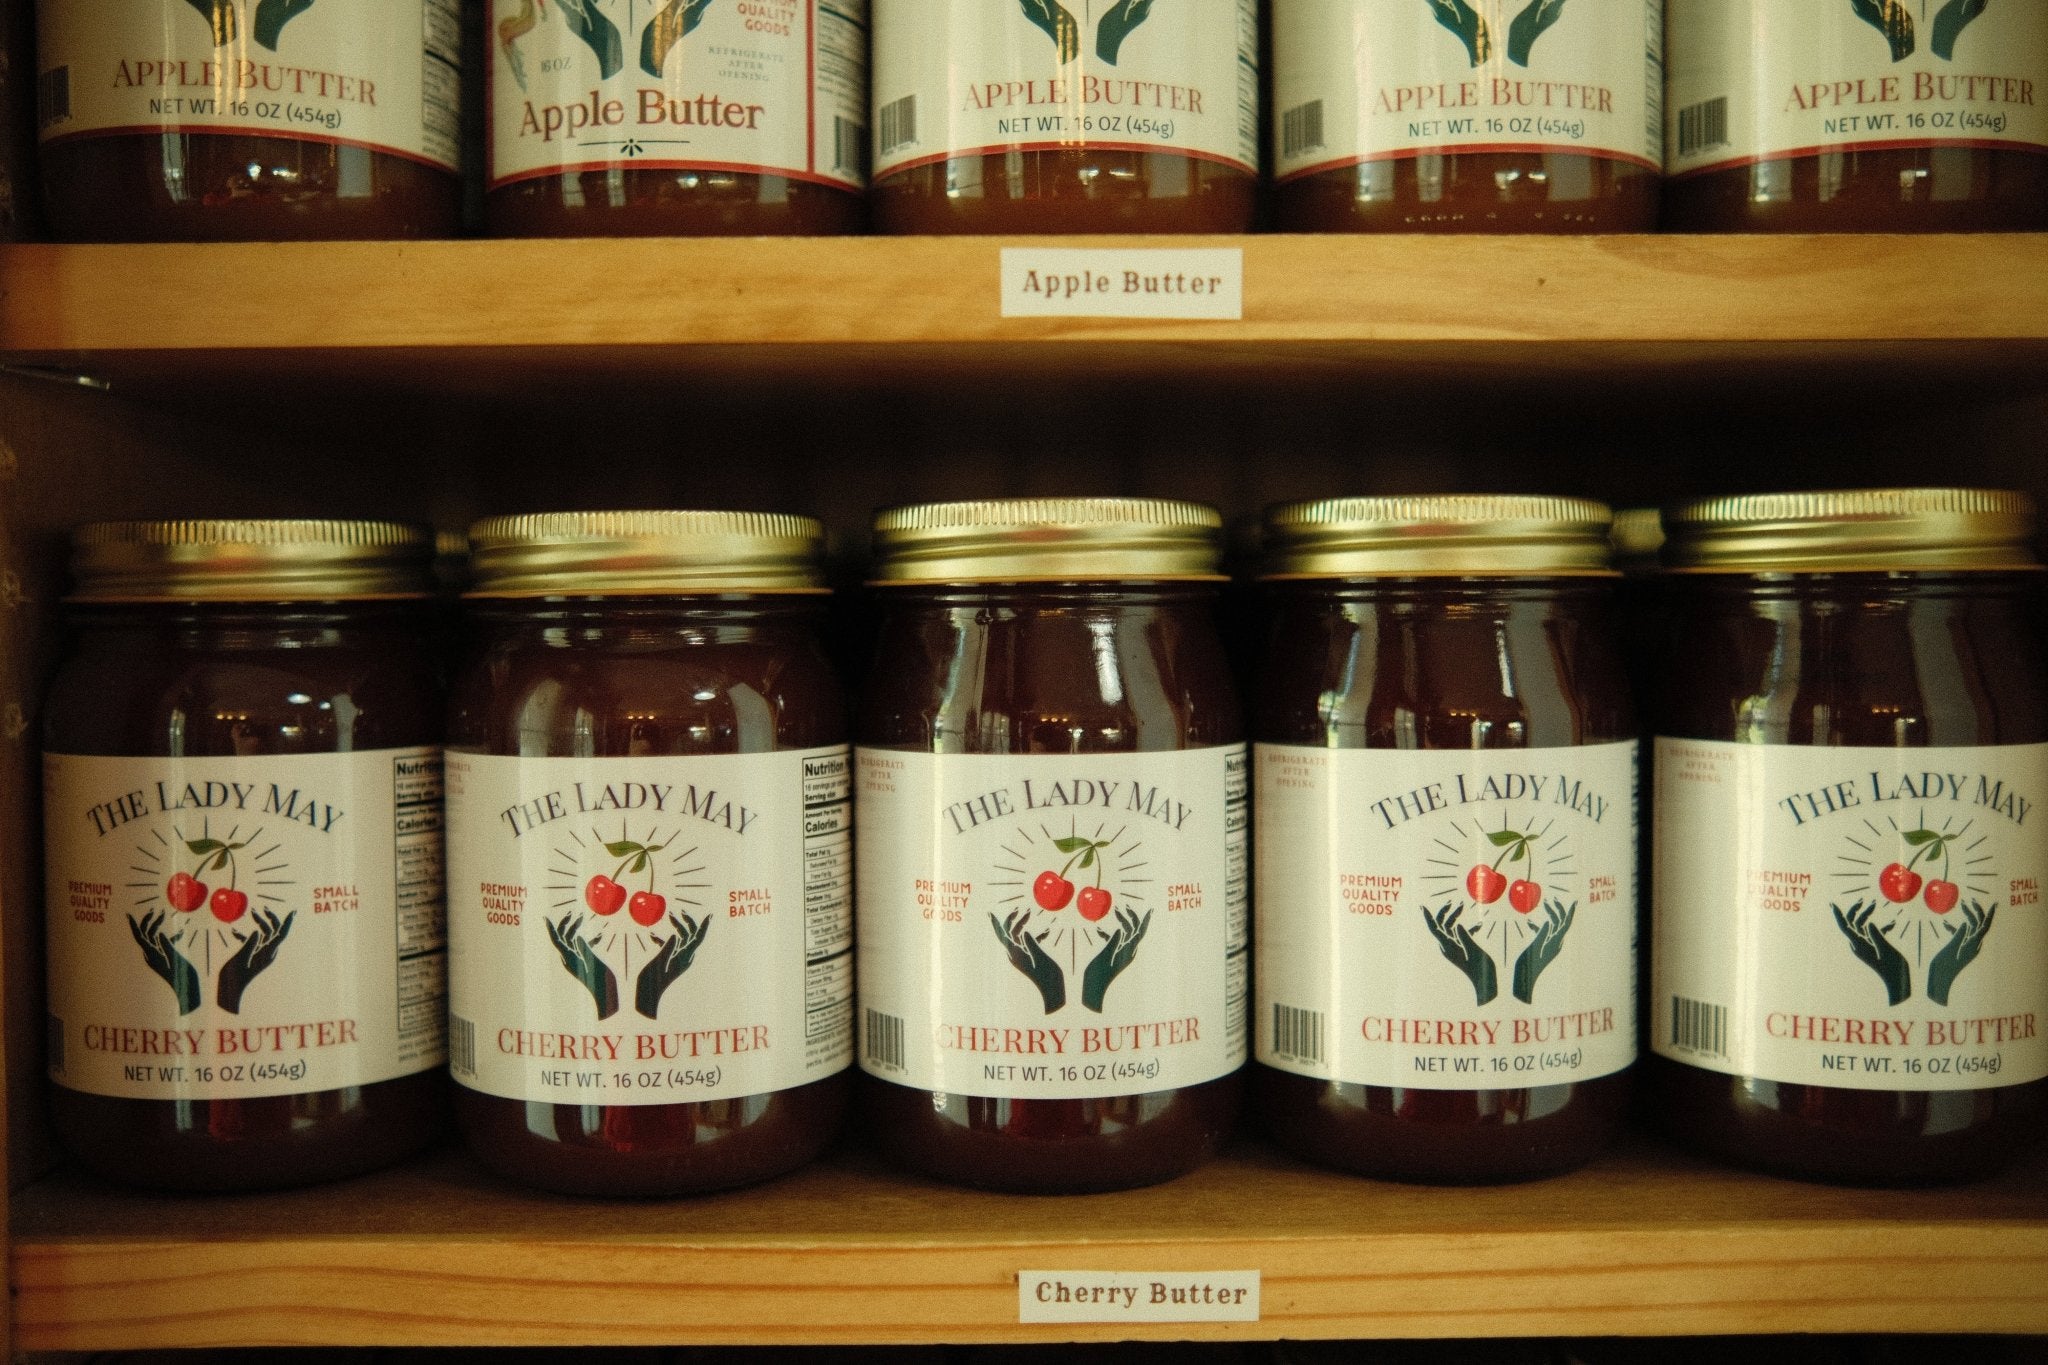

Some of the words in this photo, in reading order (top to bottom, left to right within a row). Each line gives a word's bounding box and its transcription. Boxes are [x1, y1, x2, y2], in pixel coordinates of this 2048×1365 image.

[113, 59, 223, 88] APPLE
[235, 59, 377, 106] BUTTER
[1785, 77, 1899, 112] APPLE
[1913, 72, 2035, 106] BUTTER
[962, 80, 1068, 111] APPLE
[1081, 75, 1204, 114] BUTTER
[1373, 82, 1477, 115] APPLE
[1490, 78, 1614, 113] BUTTER
[150, 99, 183, 114] NET
[190, 100, 223, 115] WT.
[230, 101, 248, 116] 16
[255, 102, 280, 118] OZ
[287, 103, 342, 129] (454g)
[520, 90, 624, 141] Apple
[636, 89, 765, 129] Butter
[1824, 117, 1860, 133] NET
[1866, 115, 1898, 130] WT.
[1905, 114, 1923, 128] 16
[1931, 113, 1954, 128] OZ
[1959, 111, 2007, 132] (454g)
[999, 117, 1029, 133] NET
[1037, 116, 1068, 131] WT.
[1075, 117, 1092, 131] 16
[1099, 117, 1121, 131] OZ
[1126, 117, 1175, 138] (454g)
[1409, 121, 1441, 137] NET
[1447, 119, 1479, 133] WT.
[1485, 119, 1502, 132] 16
[1510, 119, 1532, 133] OZ
[1537, 118, 1585, 138] (454g)
[1023, 270, 1110, 298] Apple
[1123, 271, 1222, 294] Butter
[86, 789, 149, 838] THE
[155, 781, 255, 811] LADY
[263, 783, 344, 834] MAY
[942, 788, 1015, 836] THE
[1022, 779, 1120, 810] LADY
[1126, 781, 1193, 832] MAY
[1371, 783, 1448, 830] THE
[1456, 773, 1548, 804] LADY
[1554, 775, 1610, 824] MAY
[1778, 780, 1861, 826] THE
[1870, 771, 1967, 802] LADY
[1973, 774, 2032, 826] MAY
[500, 791, 567, 839] THE
[574, 782, 673, 812] LADY
[681, 785, 758, 836] MAY
[805, 819, 838, 833] Calories
[69, 880, 112, 896] PREMIUM
[313, 885, 359, 899] SMALL
[480, 882, 527, 898] PREMIUM
[1168, 883, 1202, 897] SMALL
[1340, 875, 1403, 889] PREMIUM
[1589, 875, 1616, 889] SMALL
[2010, 879, 2038, 892] SMALL
[70, 895, 109, 910] QUALITY
[482, 897, 525, 912] QUALITY
[729, 887, 771, 902] SMALL
[917, 894, 969, 909] QULITY
[1168, 897, 1202, 912] BATCH
[1343, 888, 1400, 902] QUALITY
[1589, 889, 1616, 903] BATCH
[2010, 893, 2038, 907] BATCH
[75, 910, 105, 924] GOODS
[314, 898, 359, 914] BATCH
[729, 902, 771, 918] BATCH
[1348, 903, 1393, 915] GOODS
[487, 912, 520, 926] GOODS
[84, 1024, 204, 1055] CHERRY
[217, 1018, 359, 1054] BUTTER
[936, 1023, 1069, 1054] CHERRY
[1081, 1016, 1201, 1053] BUTTER
[1362, 1016, 1501, 1045] CHERRY
[1513, 1006, 1614, 1044] BUTTER
[1765, 1012, 1915, 1047] CHERRY
[1926, 1012, 2037, 1047] BUTTER
[498, 1027, 623, 1061] CHERRY
[635, 1025, 770, 1060] BUTTER
[125, 1065, 153, 1082] NET
[159, 1066, 188, 1082] WT.
[195, 1067, 213, 1082] 16
[220, 1066, 244, 1081] OZ
[250, 1059, 306, 1082] (454g)
[984, 1064, 1016, 1081] NET
[1022, 1067, 1052, 1081] WT.
[1059, 1066, 1077, 1081] 16
[1083, 1064, 1106, 1081] OZ
[1111, 1058, 1160, 1081] (454g)
[1414, 1057, 1446, 1072] NET
[1453, 1057, 1484, 1072] WT.
[1490, 1057, 1508, 1072] 16
[1513, 1056, 1535, 1071] OZ
[1539, 1048, 1582, 1072] (454g)
[1822, 1054, 1857, 1071] NET
[1864, 1057, 1896, 1073] WT.
[1903, 1058, 1921, 1074] 16
[1927, 1057, 1951, 1073] OZ
[1955, 1052, 2002, 1074] (454g)
[542, 1070, 571, 1086] NET
[577, 1072, 606, 1088] WT.
[614, 1072, 631, 1088] 16
[637, 1072, 662, 1087] OZ
[667, 1066, 721, 1089] (454g)
[1035, 1281, 1139, 1308] Cherry
[1150, 1282, 1247, 1304] Butter
